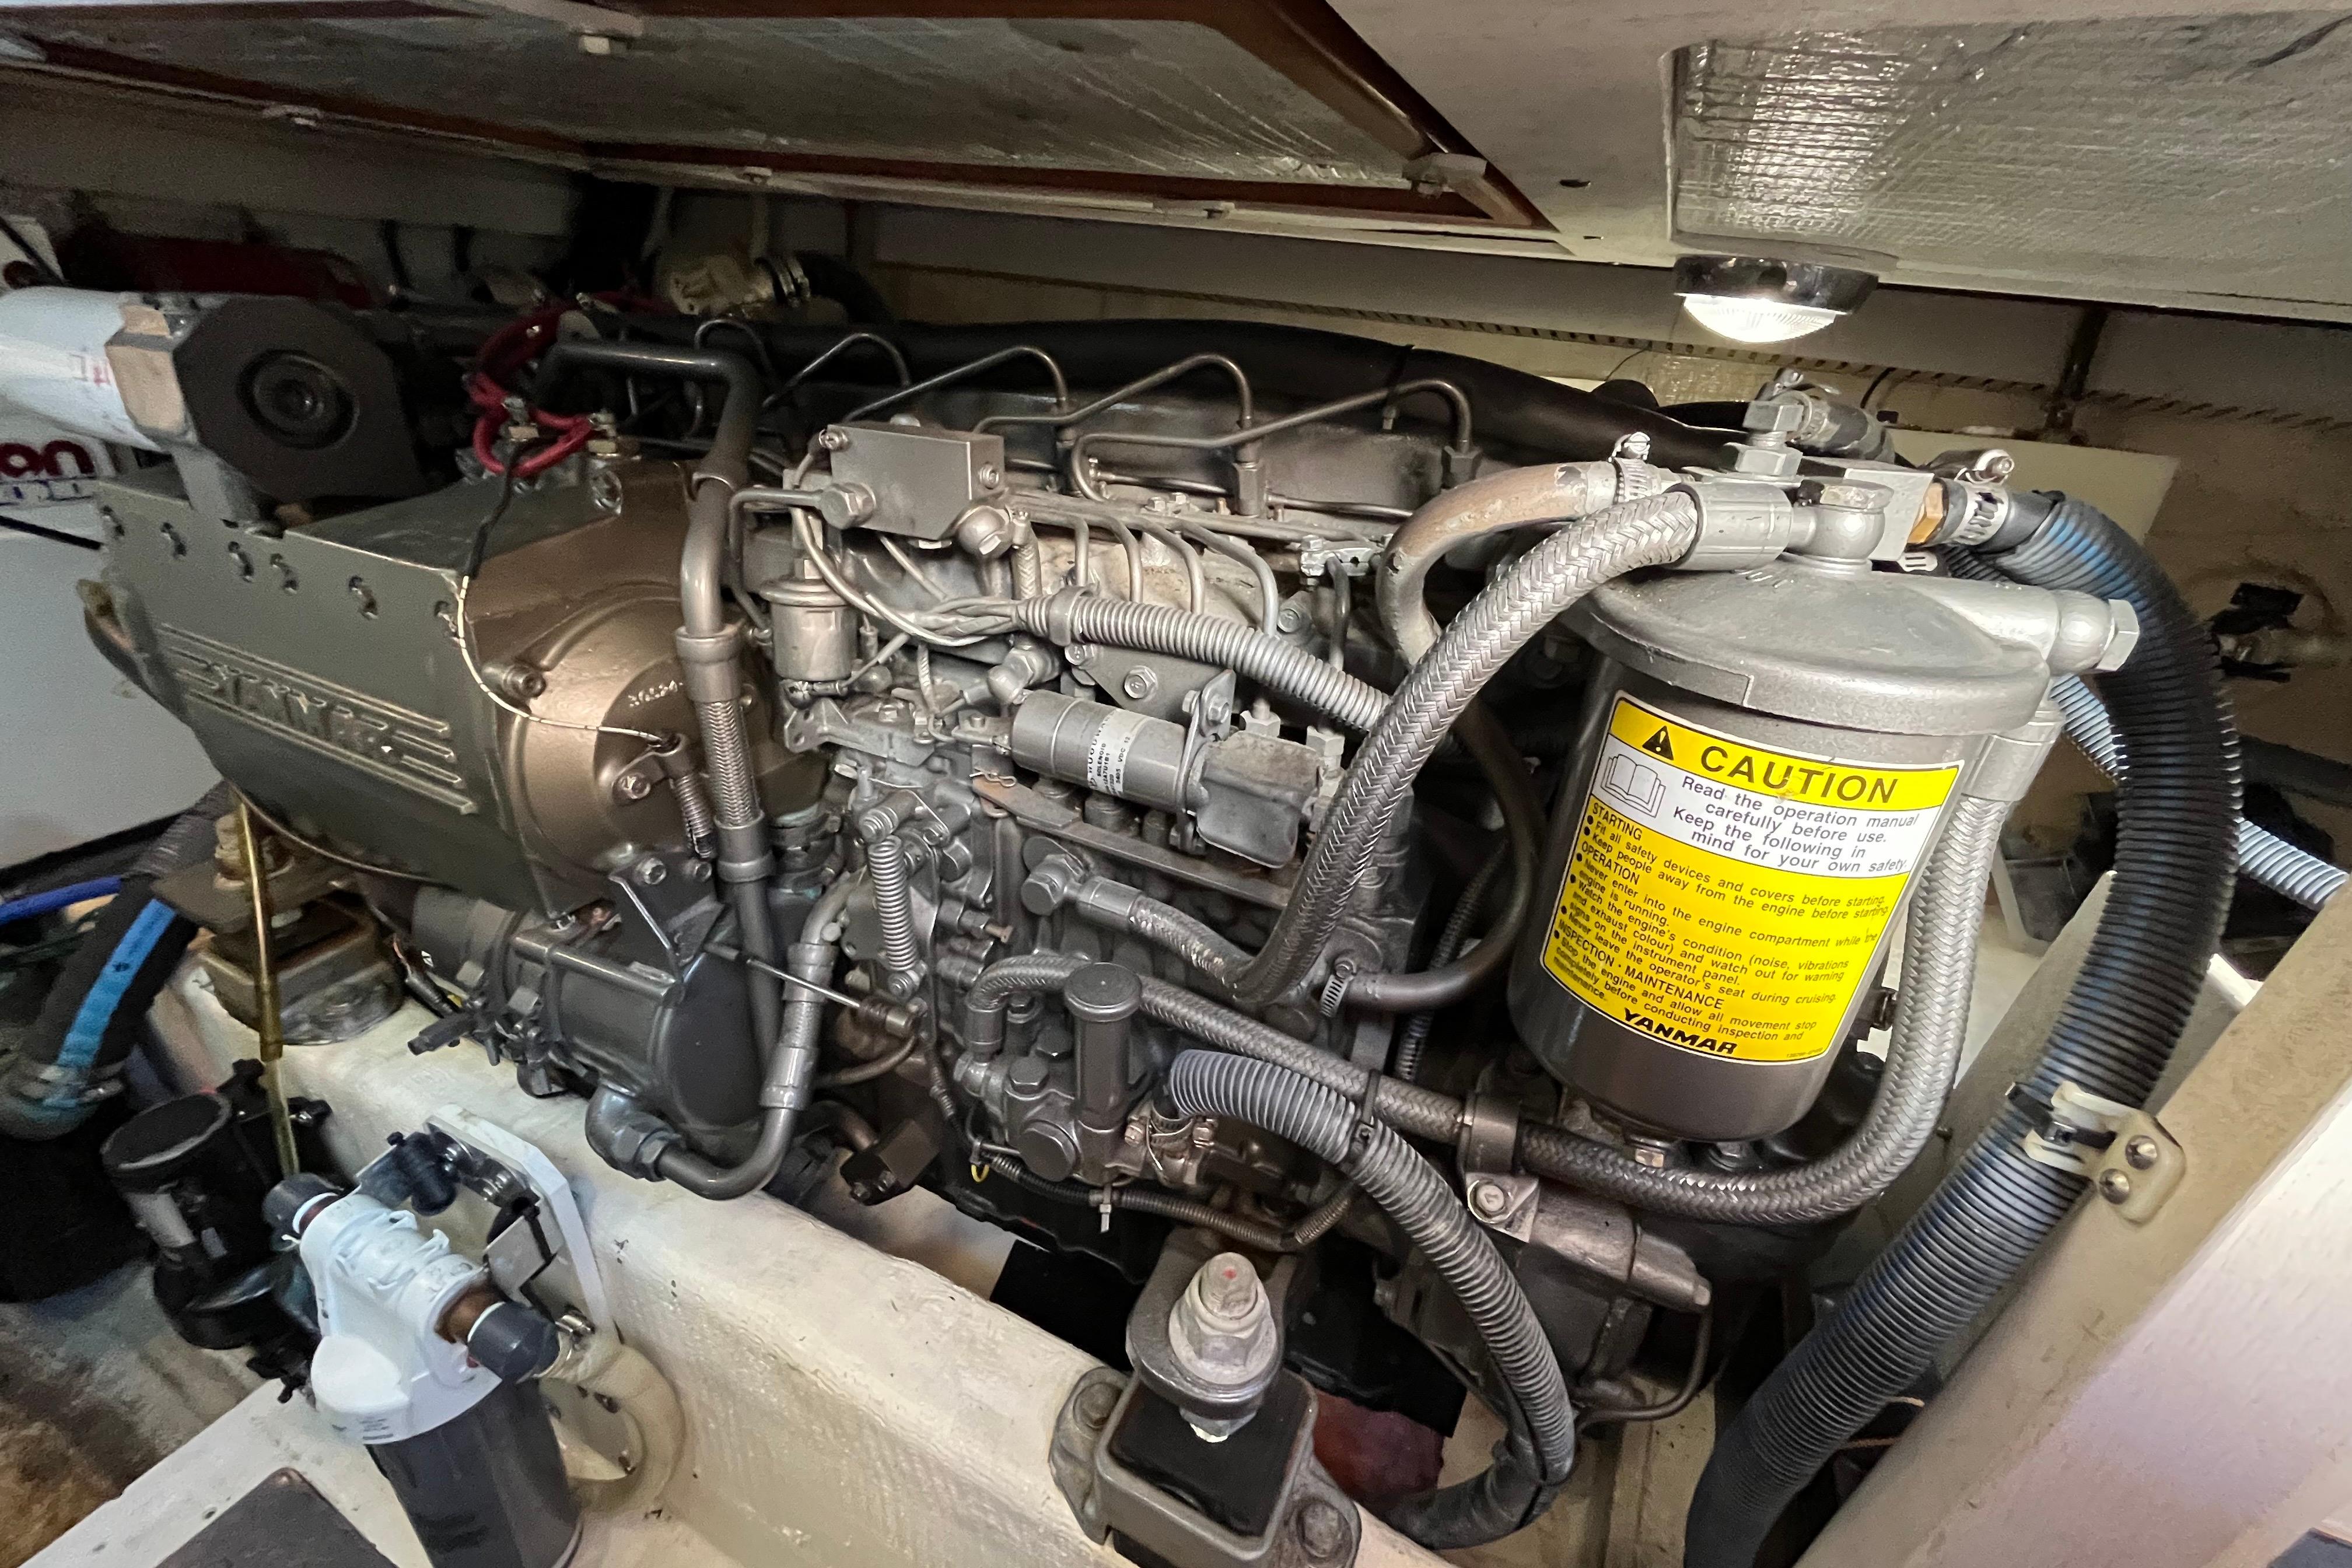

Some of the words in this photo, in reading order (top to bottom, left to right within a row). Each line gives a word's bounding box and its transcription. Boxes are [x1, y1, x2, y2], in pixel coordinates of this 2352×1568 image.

[1682, 776, 1726, 800] Read
[1735, 793, 1762, 810] the
[1773, 806, 1857, 826] operation
[1867, 813, 1920, 827] manual
[1701, 746, 1898, 803] CAUTION
[1593, 803, 1642, 841] STARTING
[1673, 806, 1714, 832] Keep
[1725, 824, 1752, 841] the
[1762, 834, 1842, 860] following
[1851, 845, 1866, 858] in
[1692, 831, 1735, 852] mind
[1744, 845, 1770, 860] for
[1777, 855, 1819, 869] your
[1828, 862, 1860, 872] own
[1868, 859, 1907, 872] safety.
[1706, 804, 1783, 835] carefully
[1792, 822, 1847, 841] before
[1857, 833, 1887, 842] use.
[1581, 841, 1640, 886] OPERATION
[1592, 832, 1613, 853] Keep
[1616, 851, 1652, 873] people
[1658, 871, 1689, 890] away
[1696, 883, 1726, 901] from
[1733, 895, 1754, 908] the
[1761, 903, 1805, 917] engine
[1811, 908, 1849, 919] before
[1609, 832, 1622, 844] all
[1625, 842, 1658, 864] safety
[1663, 859, 1711, 883] devices
[1718, 879, 1744, 892] and
[1750, 887, 1795, 902] covers
[1801, 894, 1841, 907] before
[1579, 870, 1606, 894] engine
[1610, 889, 1619, 901] is
[1624, 900, 1670, 927] running.
[1579, 880, 1603, 905] Watch
[1607, 901, 1623, 916] the
[1628, 915, 1676, 941] engine's
[1682, 938, 1742, 961] condition
[1749, 954, 1790, 970] (noise,
[1798, 960, 1849, 970] vibrations
[1585, 858, 1608, 881] Never
[1612, 880, 1639, 898] enter
[1643, 894, 1665, 911] into
[1672, 907, 1692, 921] the
[1699, 918, 1742, 936] engine
[1749, 932, 1831, 947] compartment
[1835, 936, 1861, 947] while
[1559, 919, 1614, 967] INSPECTION
[1625, 965, 1725, 1010] MAINTENANCE
[1569, 912, 1591, 935] Never
[1595, 932, 1620, 953] leave
[1626, 950, 1643, 964] the
[1718, 986, 1745, 998] seat
[1751, 992, 1790, 1006] during
[1590, 905, 1628, 932] exhaust
[1633, 929, 1674, 956] colour)
[1680, 950, 1704, 963] and
[1711, 959, 1748, 974] watch
[1755, 970, 1776, 979] out
[1782, 971, 1799, 981] for
[1804, 971, 1845, 982] warning
[1594, 921, 1606, 932] on
[1611, 929, 1628, 944] the
[1633, 940, 1697, 974] instrument
[1702, 970, 1740, 985] panel.
[1583, 954, 1597, 970] the
[1601, 968, 1636, 991] engine
[1642, 989, 1664, 1003] and
[1670, 1000, 1702, 1016] allow
[1708, 1012, 1724, 1022] all
[1730, 1017, 1790, 1030] movement
[1795, 1021, 1817, 1031] stop
[1605, 981, 1638, 1005] before
[1644, 1003, 1711, 1032] conducting
[1718, 1024, 1778, 1040] inspection
[1783, 1031, 1804, 1041] and
[1624, 1007, 1738, 1054] YANMAR
